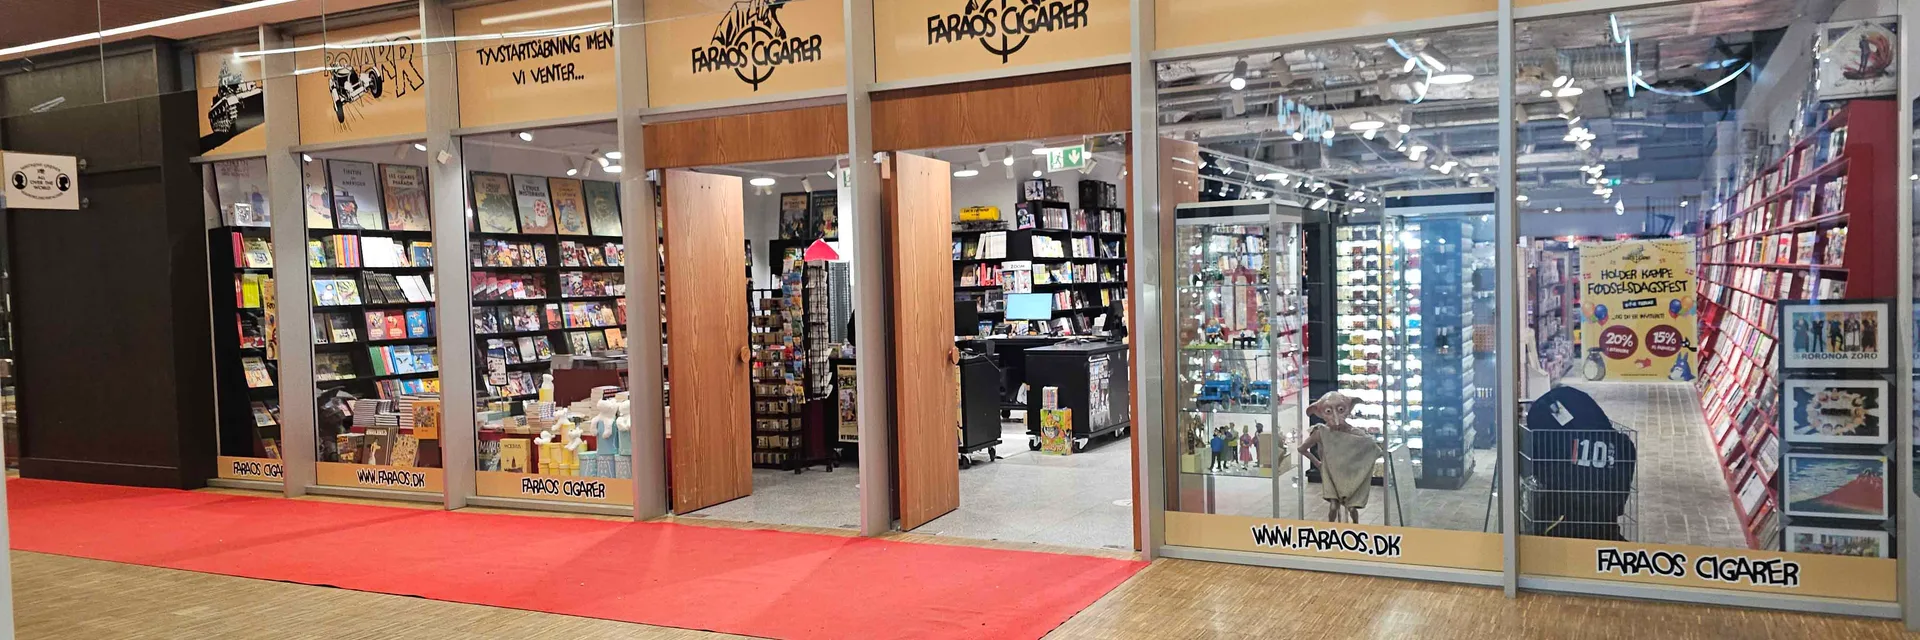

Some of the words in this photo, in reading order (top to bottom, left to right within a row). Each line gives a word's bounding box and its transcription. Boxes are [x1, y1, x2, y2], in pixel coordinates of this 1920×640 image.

[927, 8, 998, 45] FARAOS
[1001, 0, 1089, 34] CIGARER
[476, 35, 581, 66] TYVSTARTSÅBNING
[691, 41, 749, 74] FARAOS
[751, 34, 823, 66] CIGARER
[512, 69, 526, 85] VI
[530, 62, 585, 84] VENTER...
[1600, 268, 1637, 281] HOLDER
[1588, 280, 1688, 295] FØDSELSDAGSFEST
[1605, 332, 1634, 347] 20%
[1652, 331, 1677, 345] 15%
[1801, 352, 1849, 360] RORONOA
[1851, 352, 1878, 360] ZORO
[1577, 439, 1607, 468] 10
[233, 461, 261, 476] FARAOS
[357, 468, 425, 488] WWW.FARAOS.DK
[522, 477, 560, 495] FARAOS
[563, 480, 606, 498] CIGARER
[1252, 524, 1401, 557] WWW.FARAOS.DK
[1597, 548, 1687, 577] FARAOS
[1695, 556, 1800, 586] CIGARER
